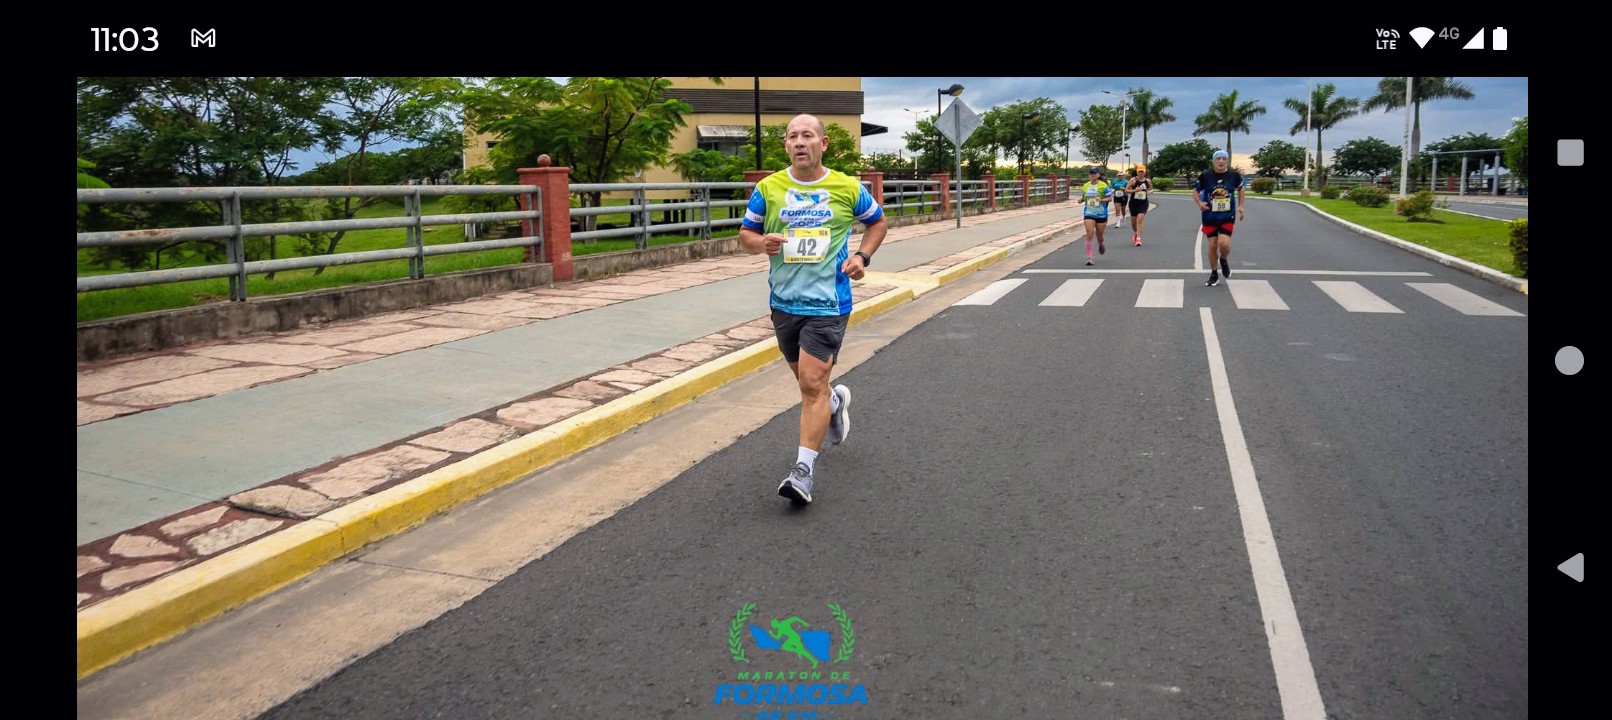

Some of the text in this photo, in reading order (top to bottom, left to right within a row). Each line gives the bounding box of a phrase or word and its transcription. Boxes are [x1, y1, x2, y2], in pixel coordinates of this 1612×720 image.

[90, 26, 160, 52] 11:03
[1438, 27, 1460, 40] 4G
[1376, 39, 1397, 50] LTE
[781, 209, 832, 217] FORMOSA
[796, 238, 818, 256] 42
